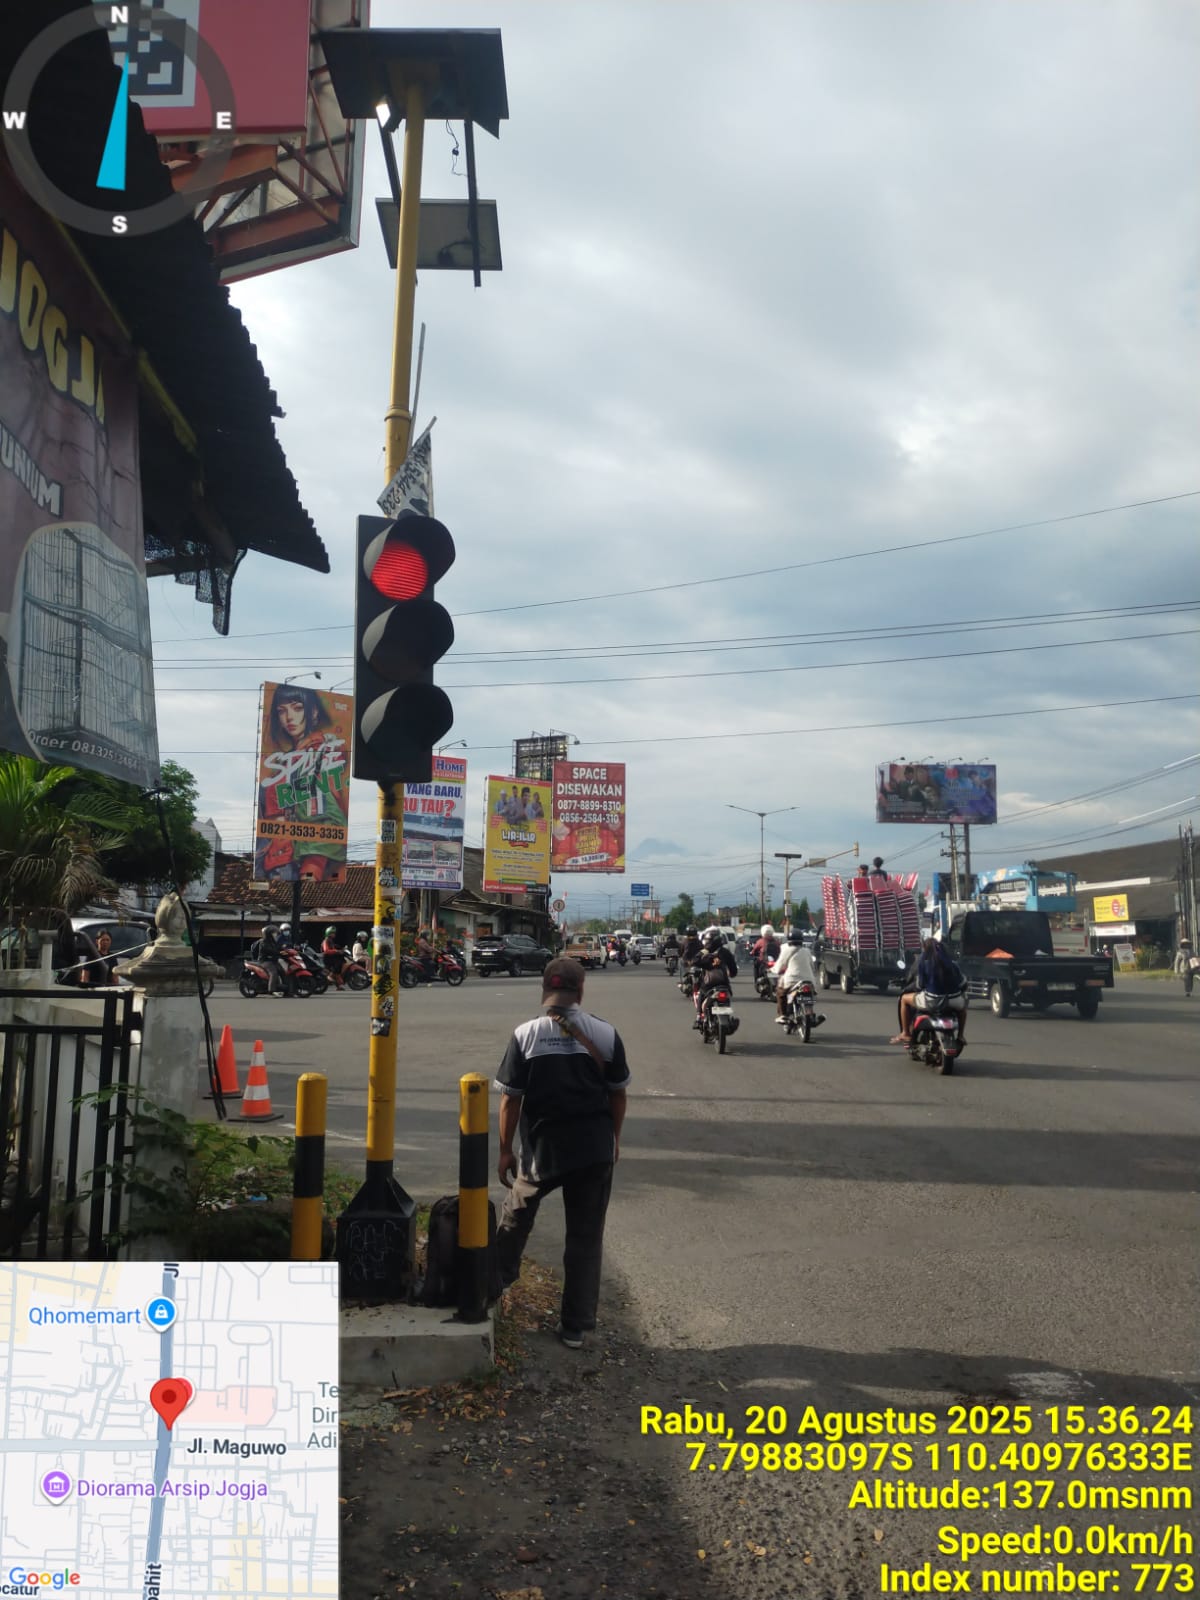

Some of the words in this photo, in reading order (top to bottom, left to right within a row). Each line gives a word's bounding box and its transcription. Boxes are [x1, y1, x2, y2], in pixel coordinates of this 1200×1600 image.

[0, 228, 105, 424] JOGJ
[0, 423, 61, 516] UNIUM
[572, 767, 607, 780] SPACE
[406, 783, 432, 796] YANG
[556, 783, 622, 796] DISEWAKAN
[421, 798, 456, 817] TAU?
[260, 822, 345, 841] 0821-3533-3335
